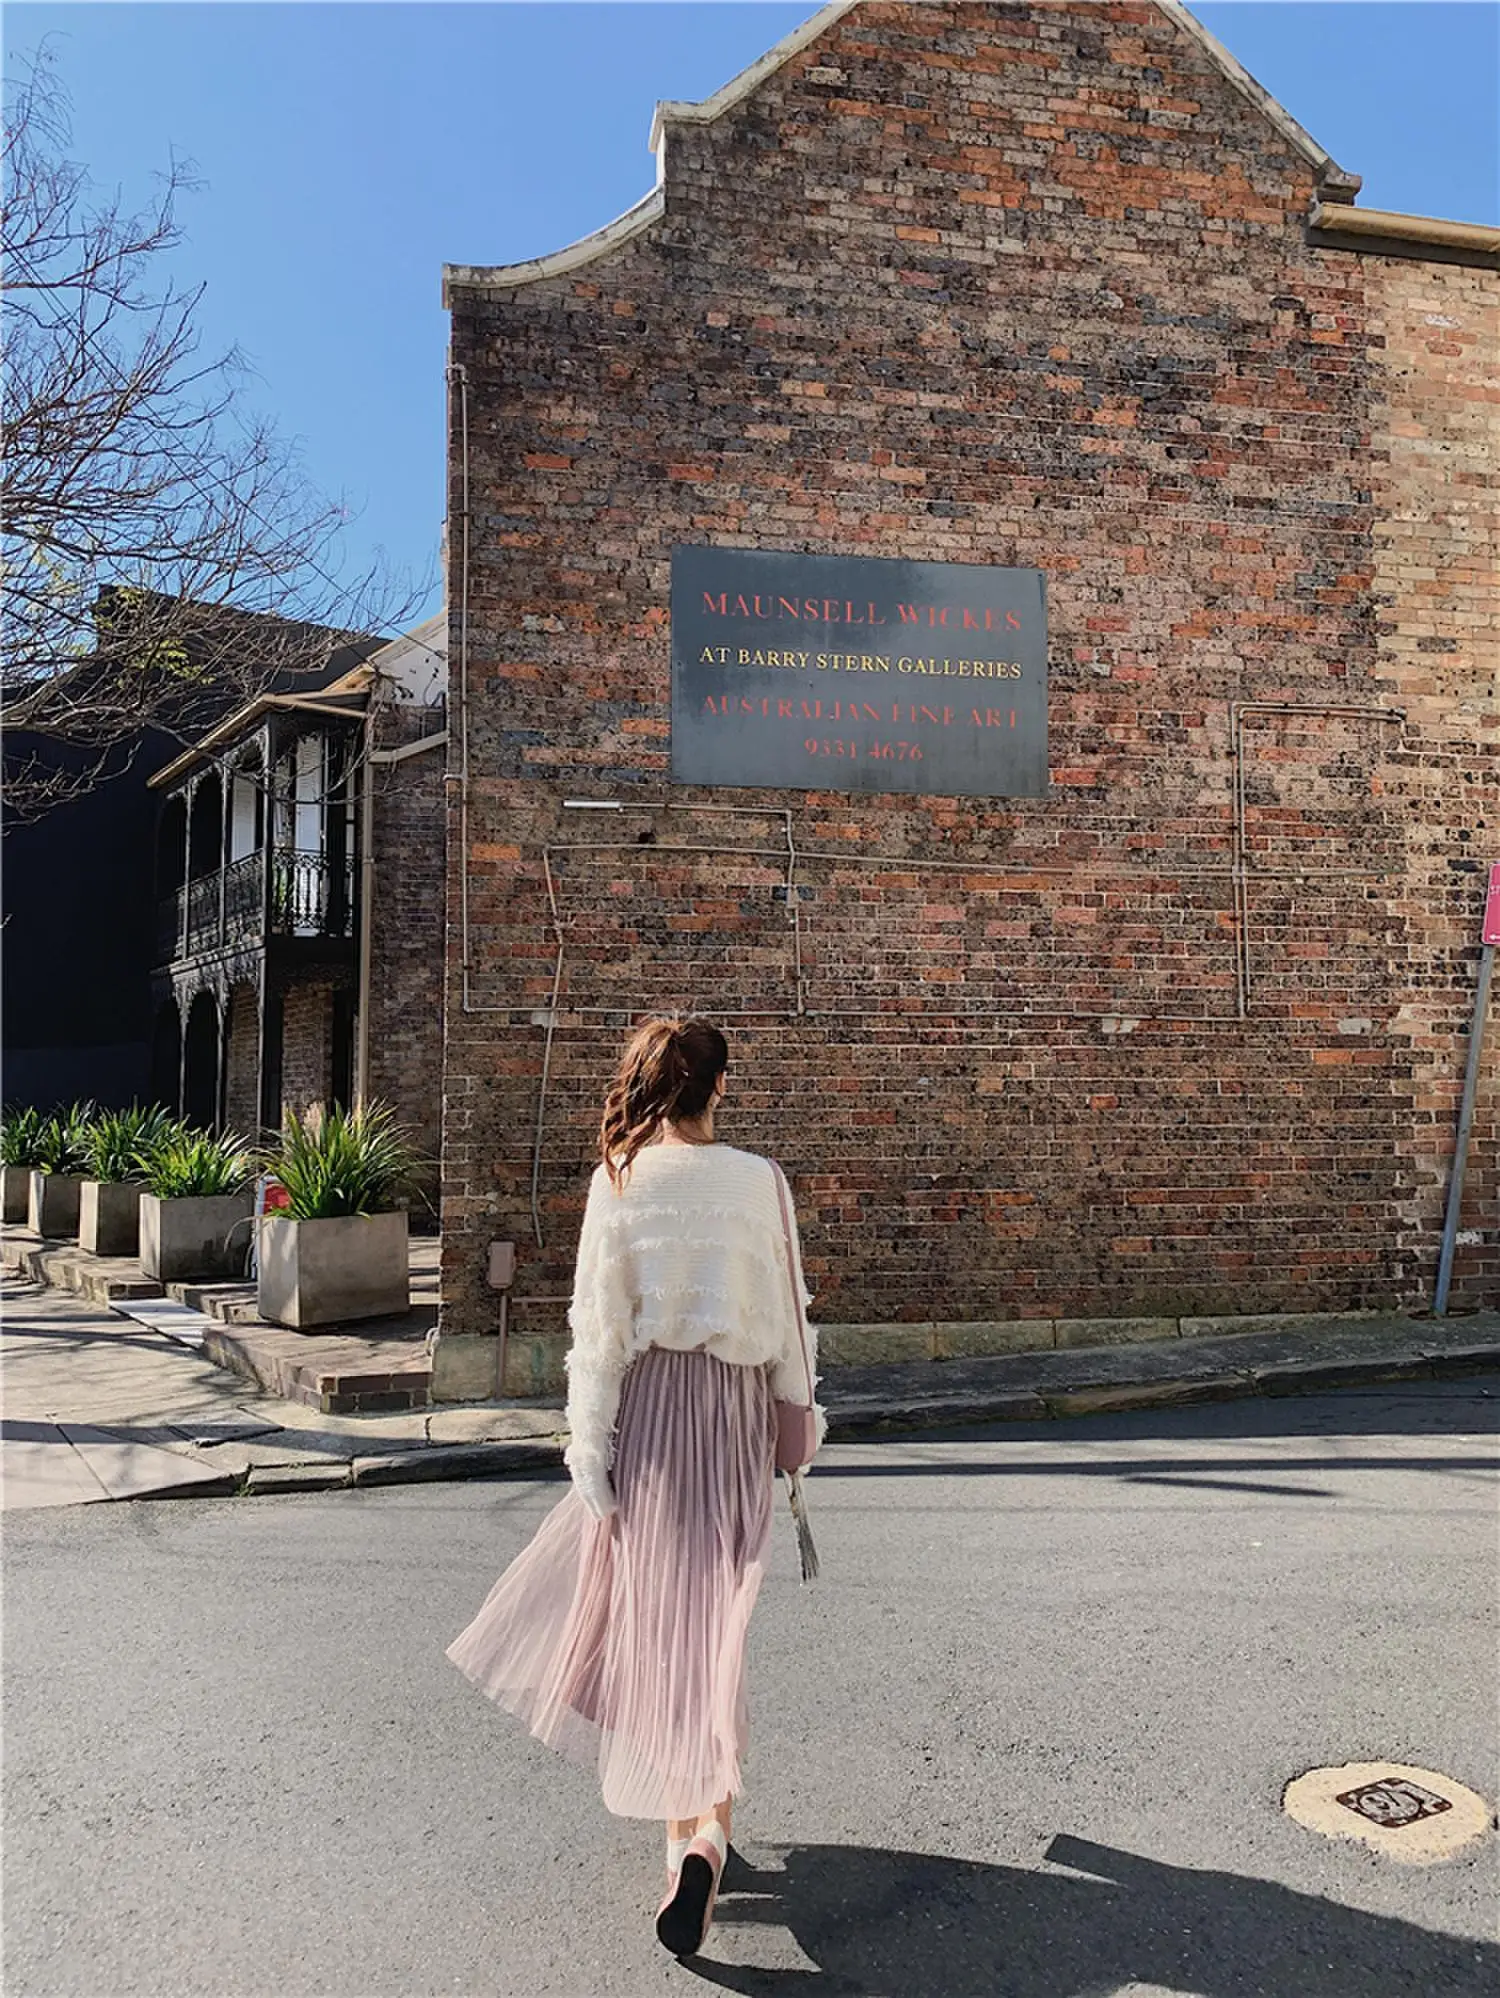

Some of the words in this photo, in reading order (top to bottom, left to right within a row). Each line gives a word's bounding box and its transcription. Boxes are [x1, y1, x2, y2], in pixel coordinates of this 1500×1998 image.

[702, 592, 886, 625] MAUNSELL
[897, 603, 1023, 632] WICKES
[699, 647, 731, 664] AT
[738, 649, 810, 668] BARRY
[816, 653, 891, 672] STERN
[898, 656, 1022, 680] GALLERIES
[702, 695, 881, 721] AUSTRALIAN
[890, 703, 956, 727] FINE
[967, 707, 1020, 730] ART
[869, 738, 924, 761] 4676
